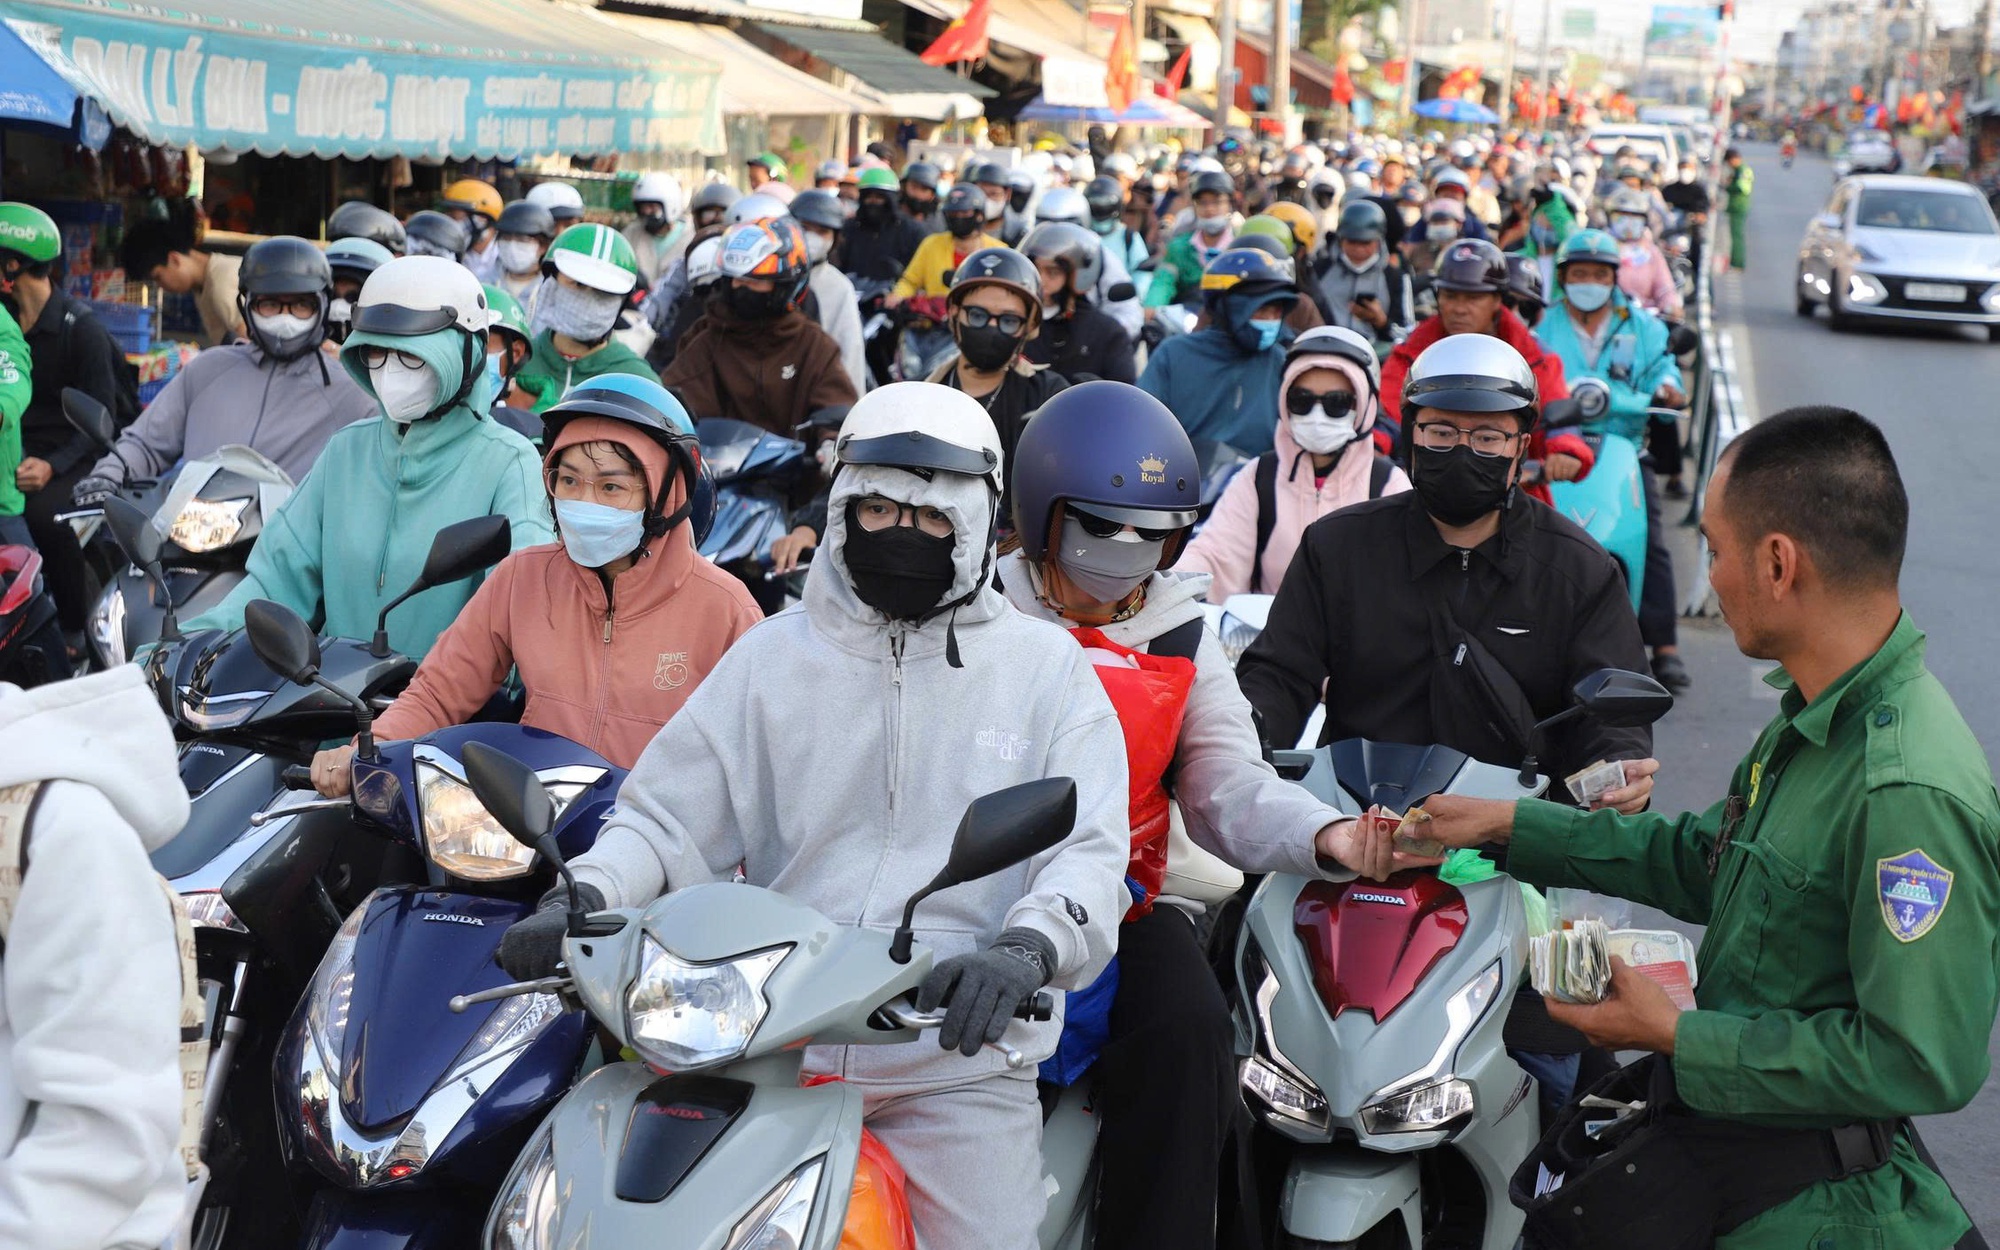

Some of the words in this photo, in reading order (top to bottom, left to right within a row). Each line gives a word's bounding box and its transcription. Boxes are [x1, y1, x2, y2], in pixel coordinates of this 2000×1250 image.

[152, 36, 203, 127] LÝ
[204, 54, 269, 133] BIA
[296, 57, 388, 140] NƯỚC
[1141, 472, 1165, 485] Royal
[1352, 893, 1407, 906] HONDA
[423, 912, 486, 927] HONDA
[645, 1106, 704, 1120] HONDA
